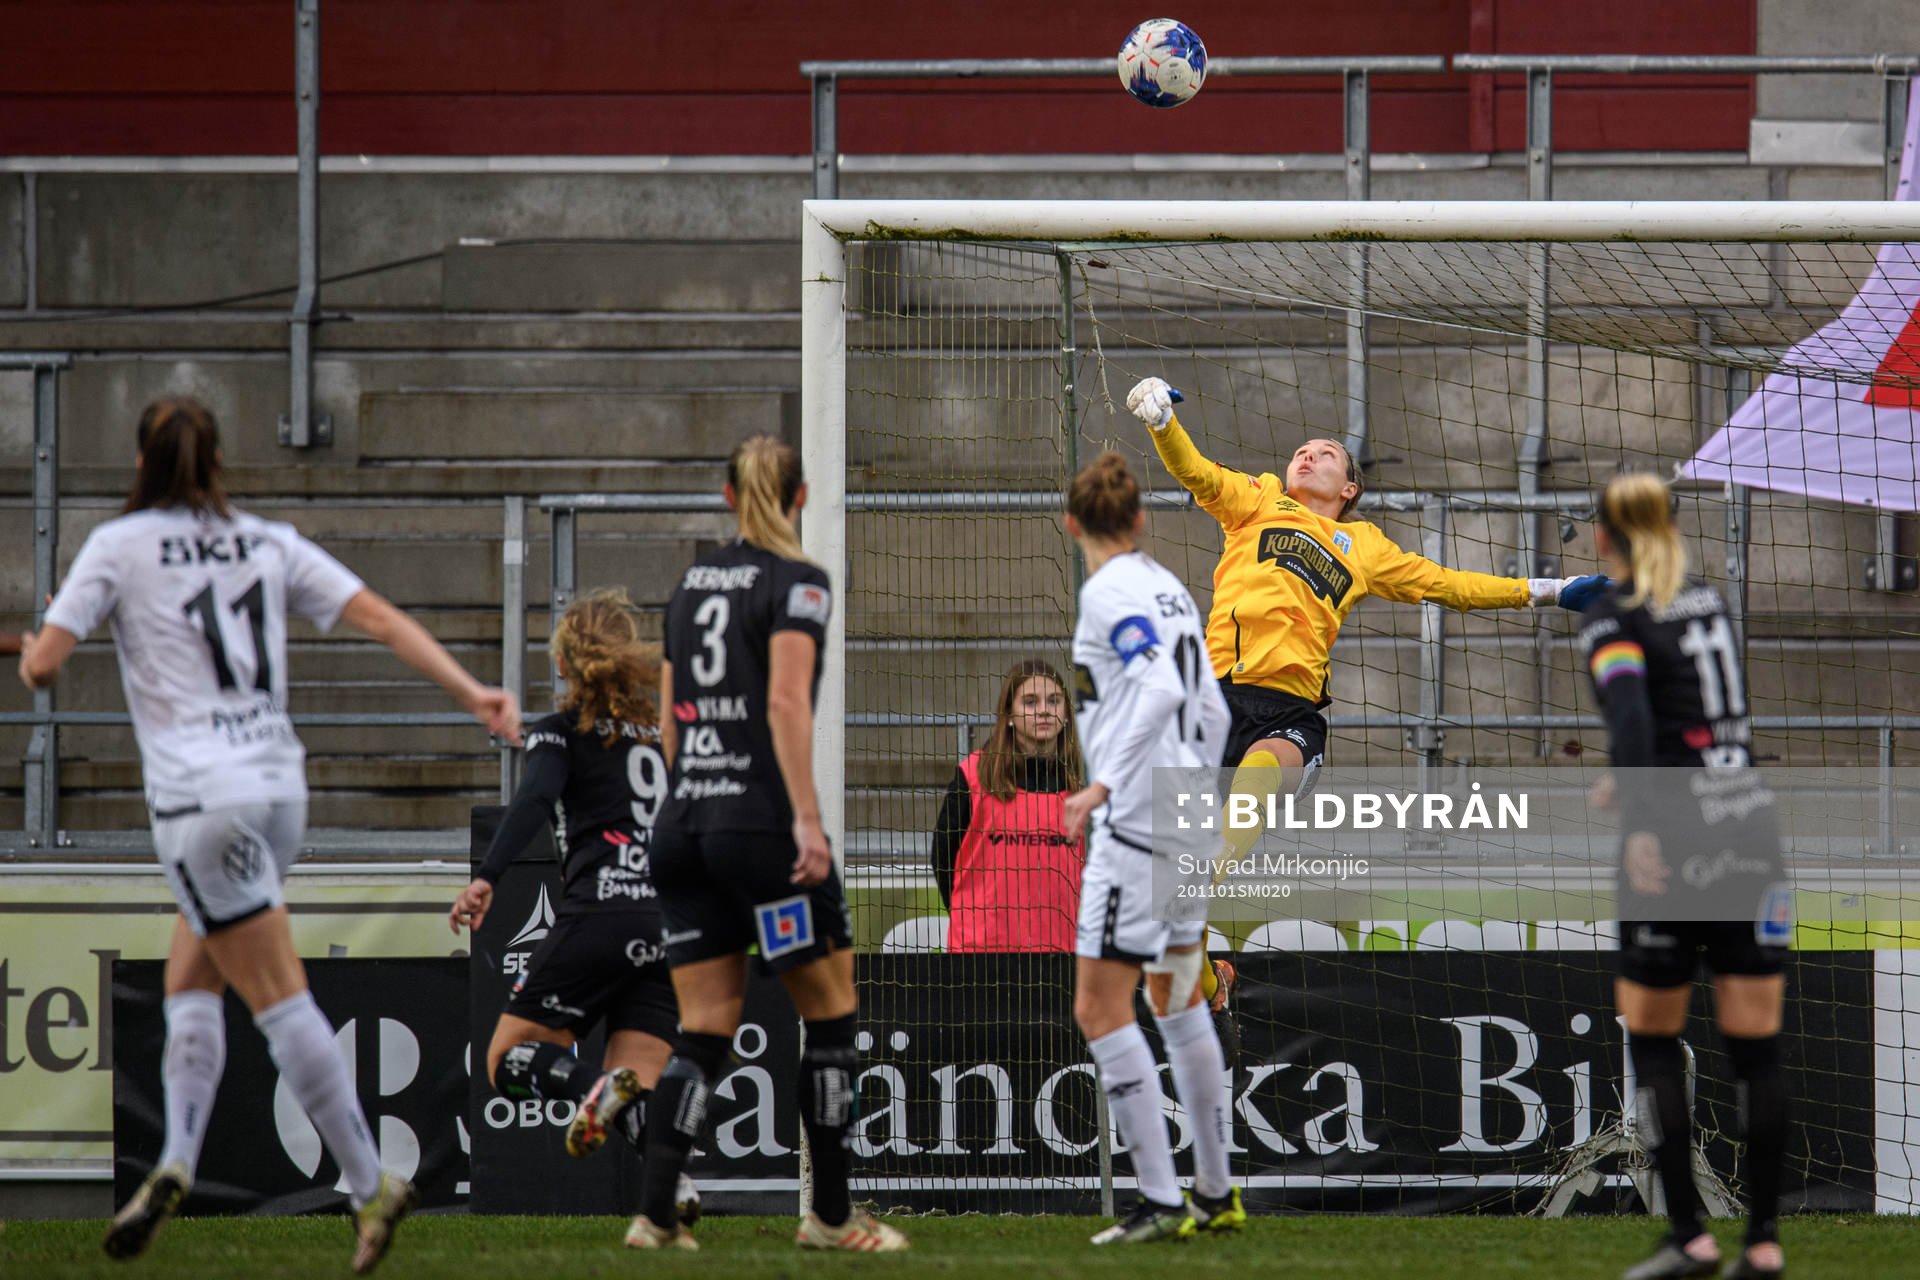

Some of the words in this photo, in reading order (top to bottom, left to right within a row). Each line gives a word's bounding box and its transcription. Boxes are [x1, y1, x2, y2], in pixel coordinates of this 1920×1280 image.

[1264, 534, 1347, 598] KOPPARBERG
[183, 577, 272, 693] 11
[691, 594, 730, 687] 3
[1679, 614, 1746, 718] 11
[627, 744, 669, 828] 9
